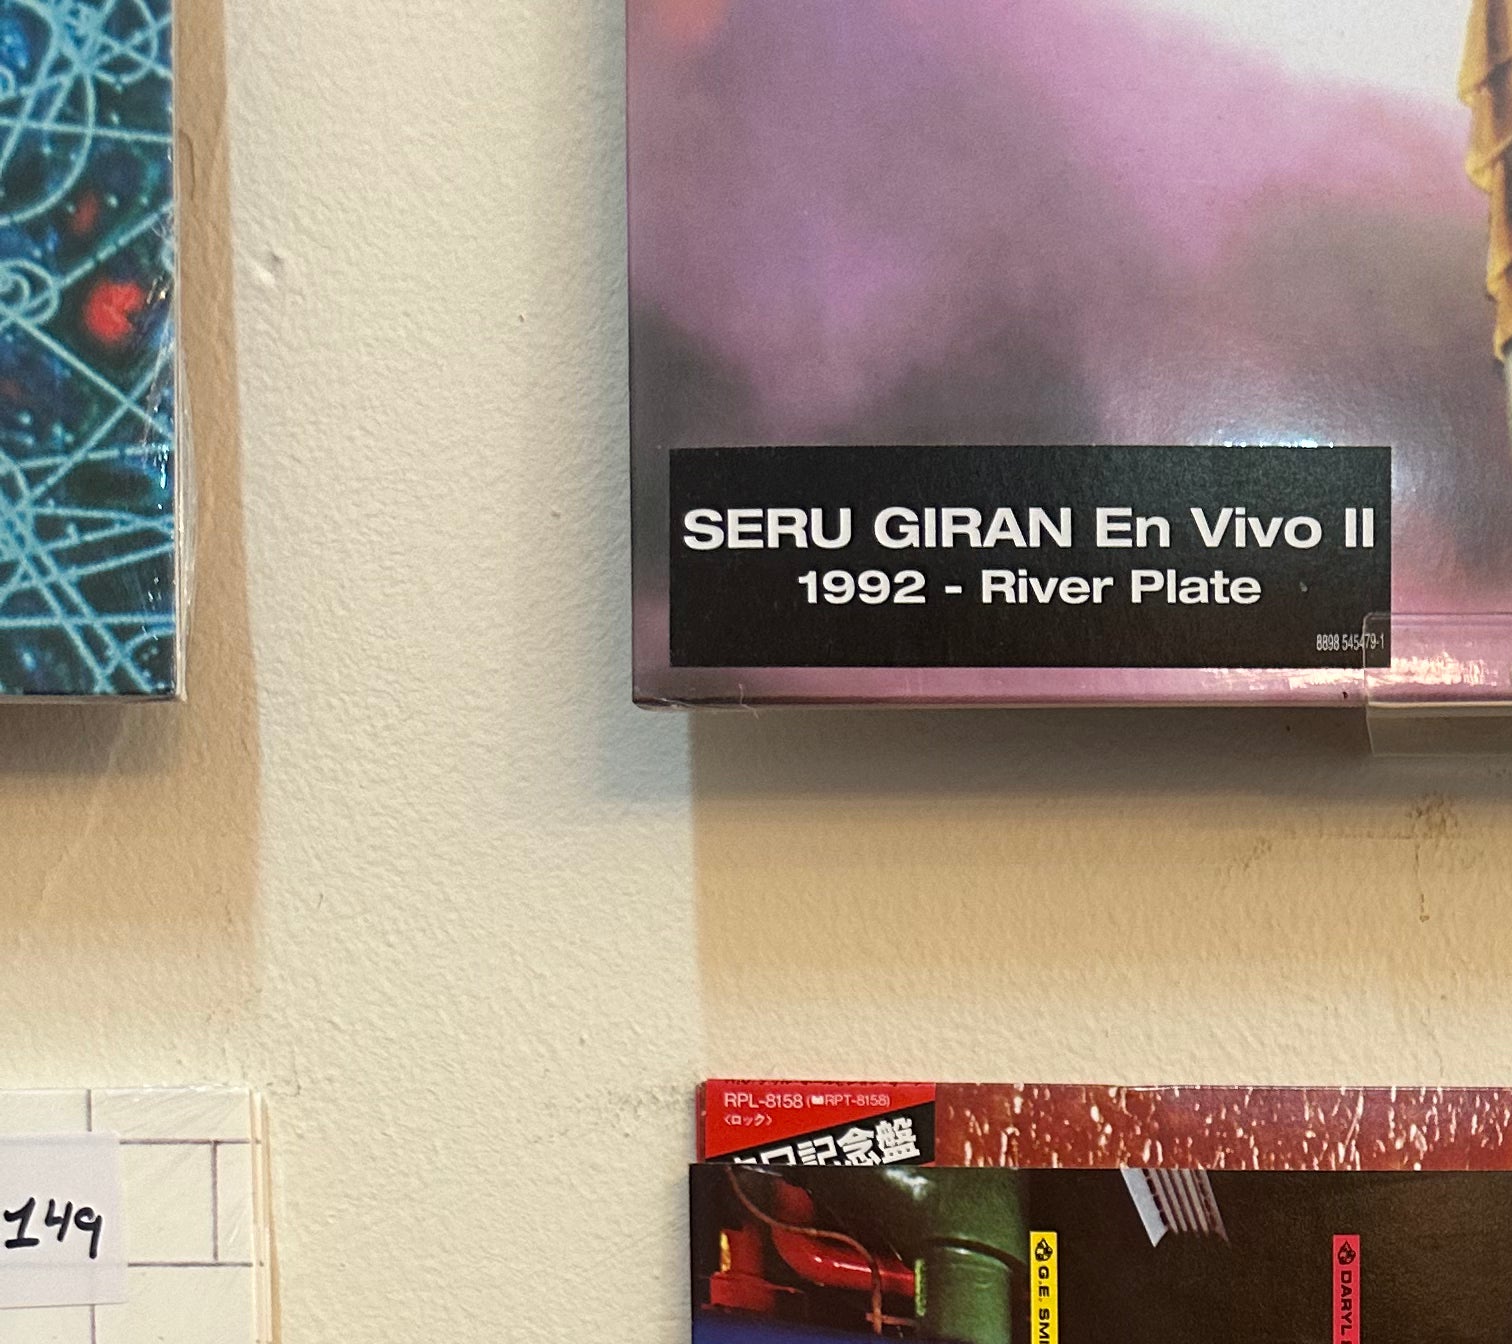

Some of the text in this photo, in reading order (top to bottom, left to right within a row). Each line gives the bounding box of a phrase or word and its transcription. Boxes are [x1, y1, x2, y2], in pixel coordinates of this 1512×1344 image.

[683, 507, 1375, 550] SERU GIRAN En Vivo II
[798, 570, 927, 604] 1992
[981, 570, 1113, 604] River
[1131, 570, 1262, 604] Plate
[1316, 633, 1340, 652] 8898
[723, 1092, 804, 1109] RPL-8158
[4, 1197, 102, 1259] 149
[1340, 1270, 1353, 1336] DARYL
